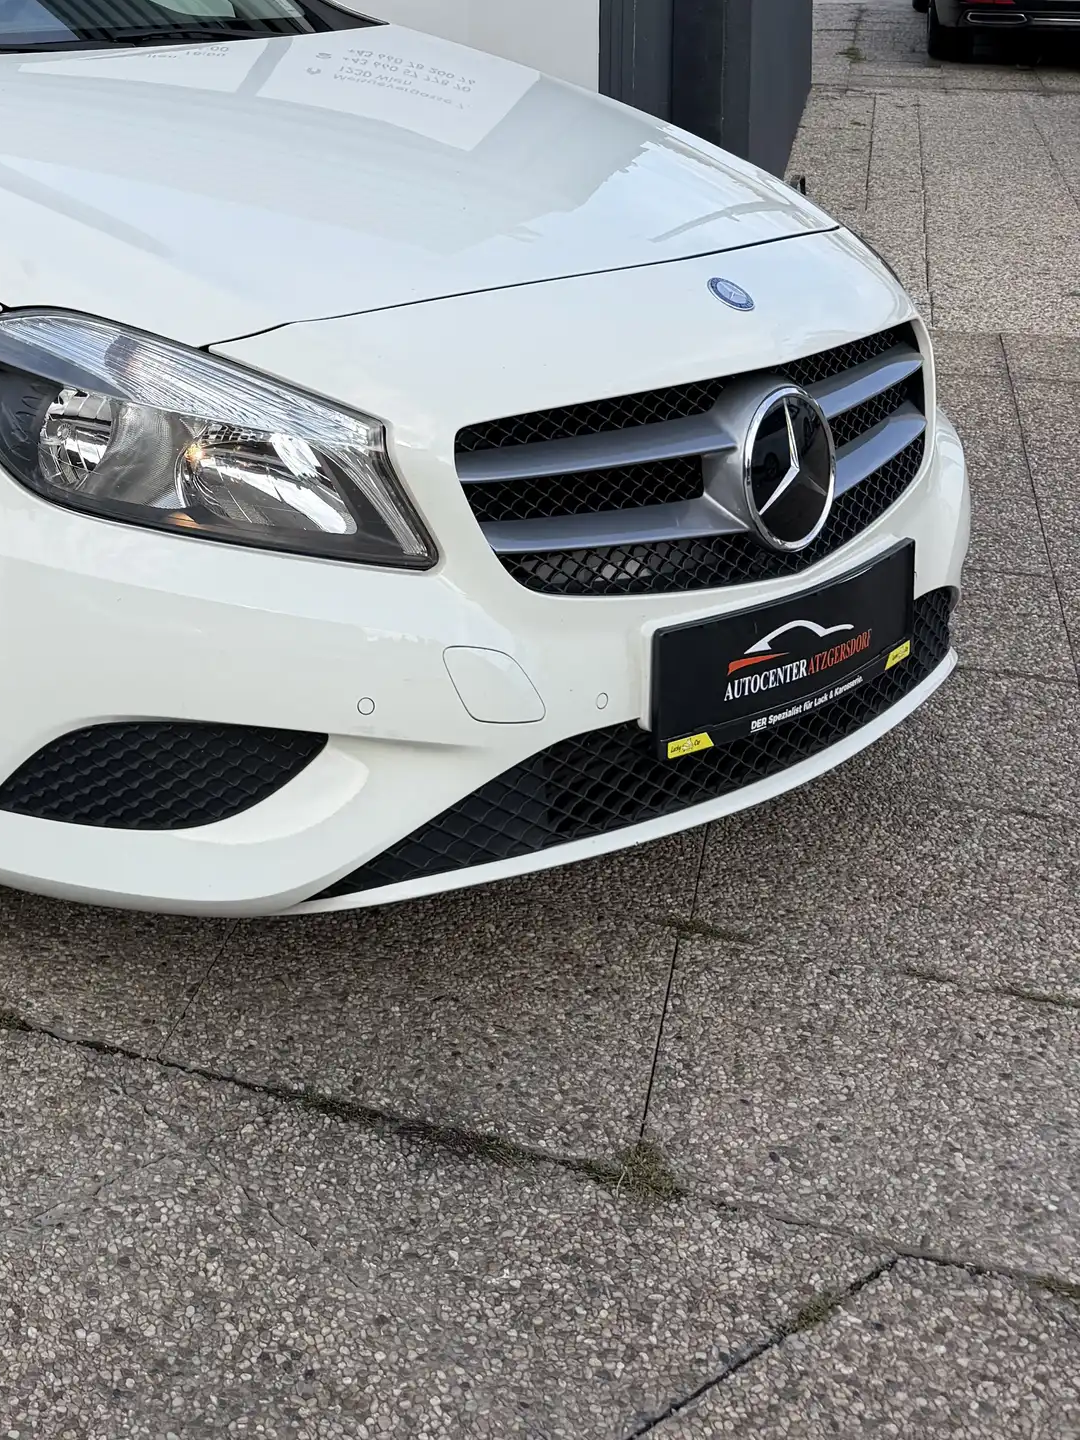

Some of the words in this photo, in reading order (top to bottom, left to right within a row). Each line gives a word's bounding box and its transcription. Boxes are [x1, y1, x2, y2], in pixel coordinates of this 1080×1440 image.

[724, 659, 808, 701] AUTOCENTER
[808, 628, 872, 675] ATZGERSDORF
[751, 717, 767, 730] DER
[768, 705, 802, 725] Spezialist
[803, 698, 814, 711] für
[814, 692, 828, 707] Lack
